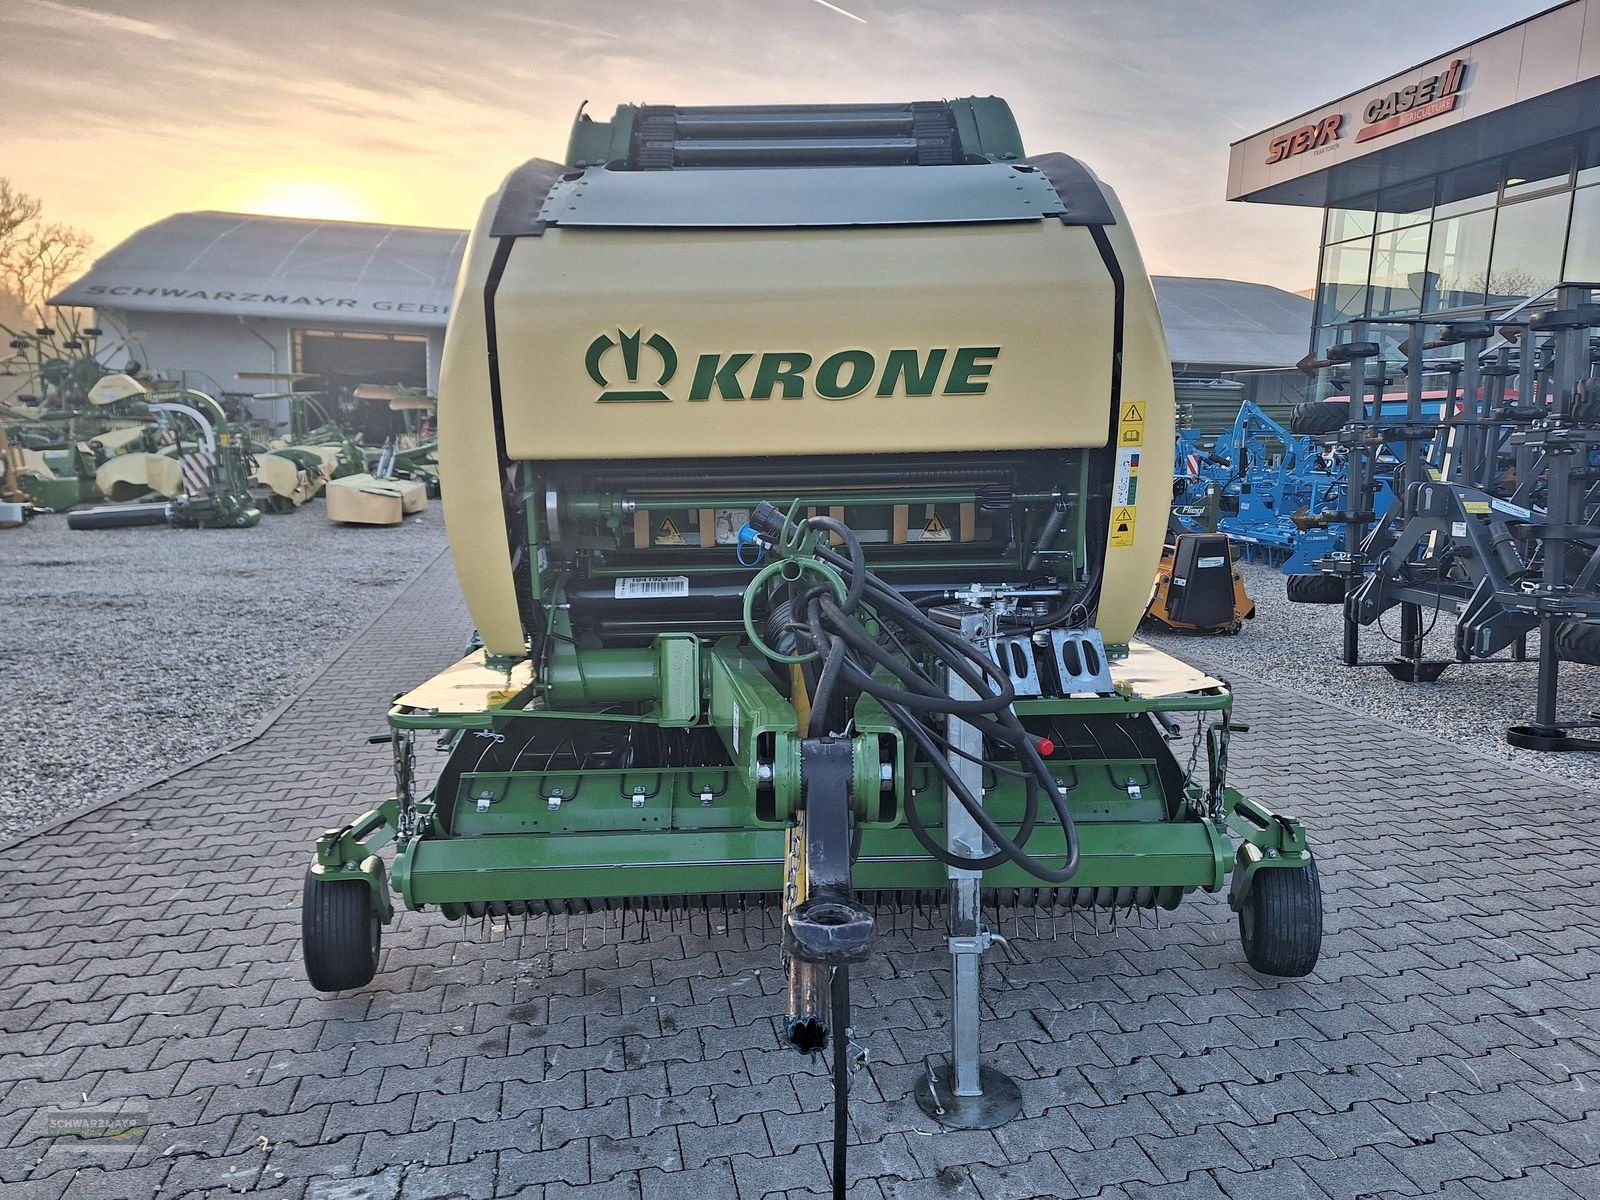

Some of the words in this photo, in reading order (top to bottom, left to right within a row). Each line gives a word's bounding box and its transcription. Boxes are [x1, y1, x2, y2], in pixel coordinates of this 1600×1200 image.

[1363, 76, 1439, 124] CASE
[1398, 98, 1452, 127] AGRICULTURE
[1265, 114, 1344, 165] STEYR
[84, 285, 358, 308] SCHWARZMAYR
[688, 346, 1001, 400] KRONE
[1181, 505, 1206, 516] Fliegl
